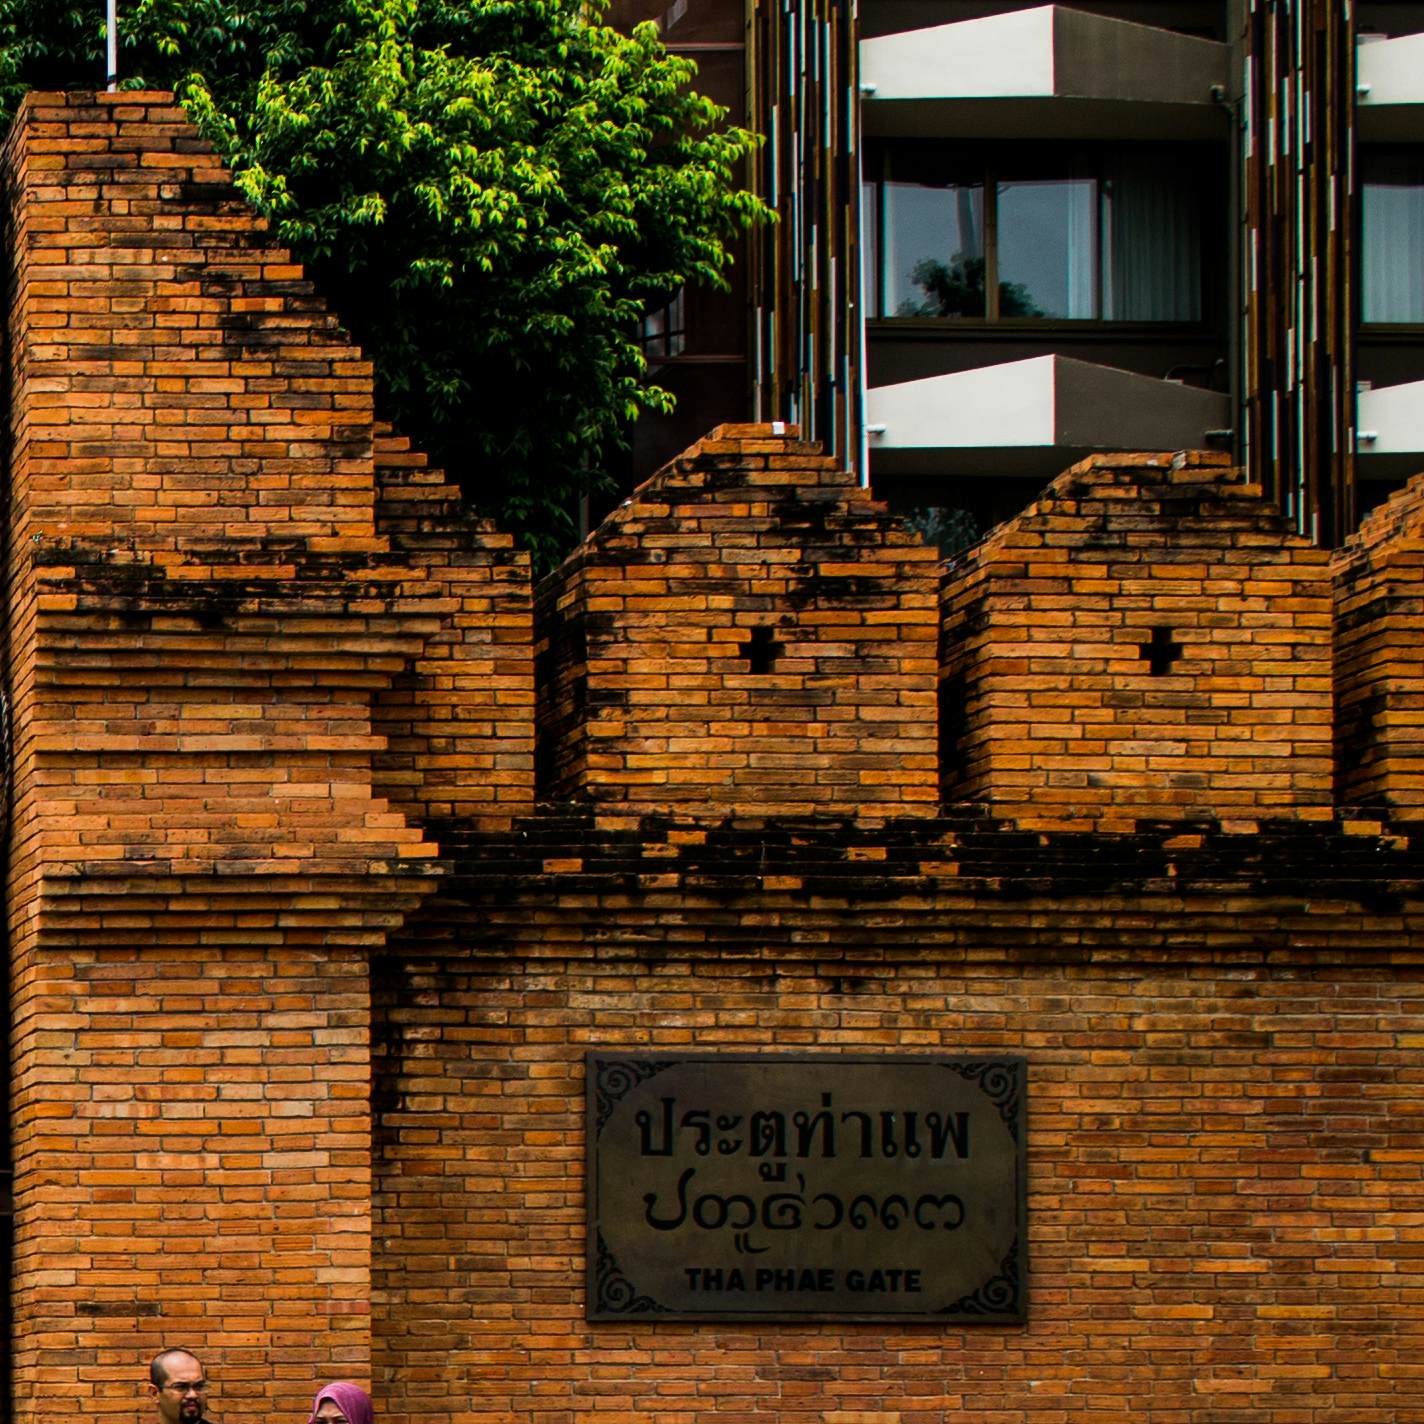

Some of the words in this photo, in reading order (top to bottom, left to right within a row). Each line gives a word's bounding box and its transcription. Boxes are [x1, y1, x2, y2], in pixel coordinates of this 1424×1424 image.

[634, 1091, 971, 1182] ประตูท่าแพ
[684, 1268, 746, 1292] THA
[755, 1268, 836, 1292] PHAE
[845, 1268, 922, 1292] GATE
